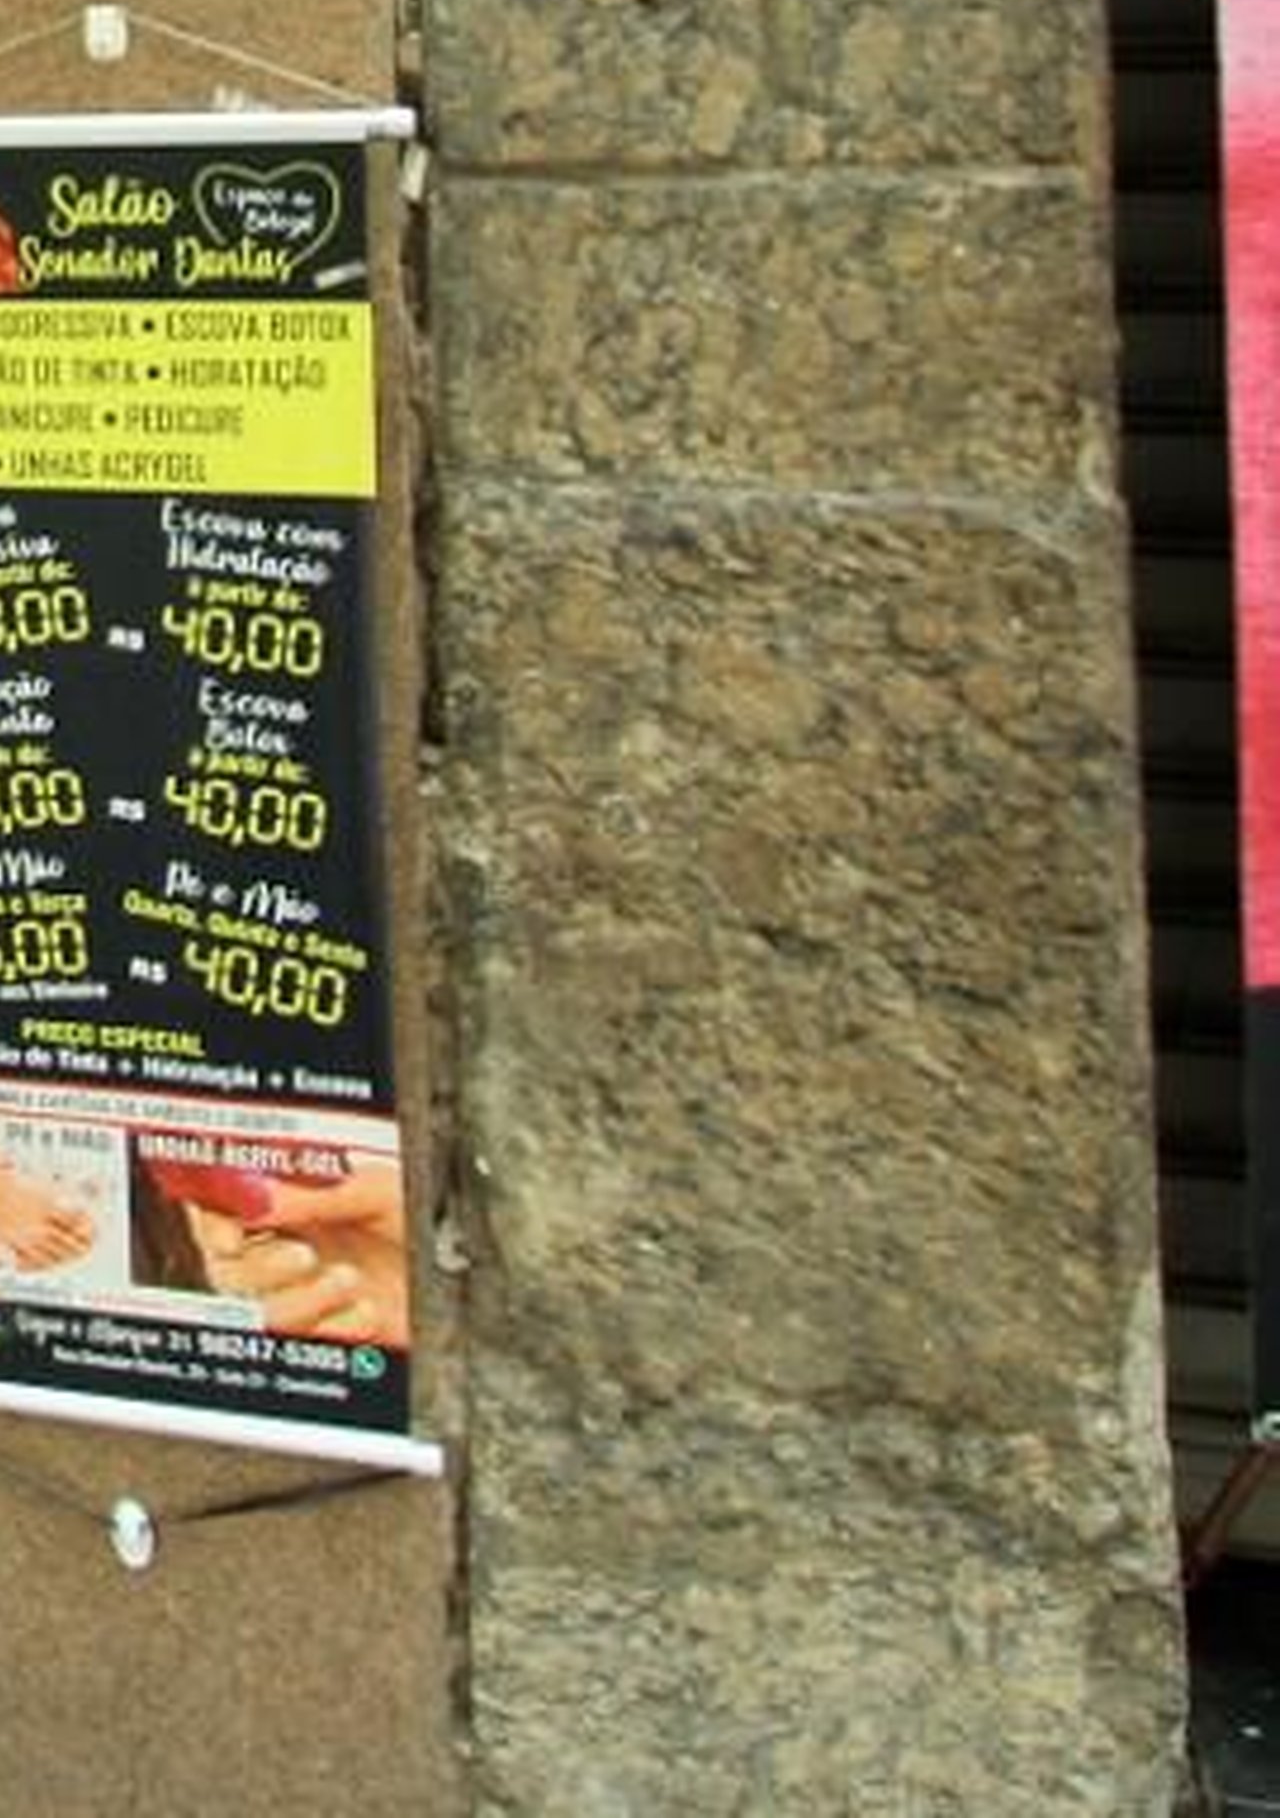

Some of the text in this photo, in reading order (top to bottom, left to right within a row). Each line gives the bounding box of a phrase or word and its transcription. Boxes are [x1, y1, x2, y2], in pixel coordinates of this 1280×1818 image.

[46, 173, 178, 237] Salão
[18, 234, 292, 290] Senador Dantas
[166, 311, 262, 342] ESCOVA
[269, 311, 352, 342] BOTOX
[33, 356, 62, 385] DE
[68, 357, 138, 386] TINTA
[169, 354, 326, 396] HIDRATAÇÃO
[123, 403, 244, 436] PEDICURE
[9, 449, 93, 479] UNHAS
[160, 497, 268, 540] Escova
[166, 533, 332, 589] Hidratação
[161, 604, 323, 676] 40,00
[198, 677, 310, 723] Escova
[164, 775, 327, 850] 40,00
[183, 941, 348, 1025] 40,00
[19, 1018, 206, 1058] PREÇO ESPECIAL
